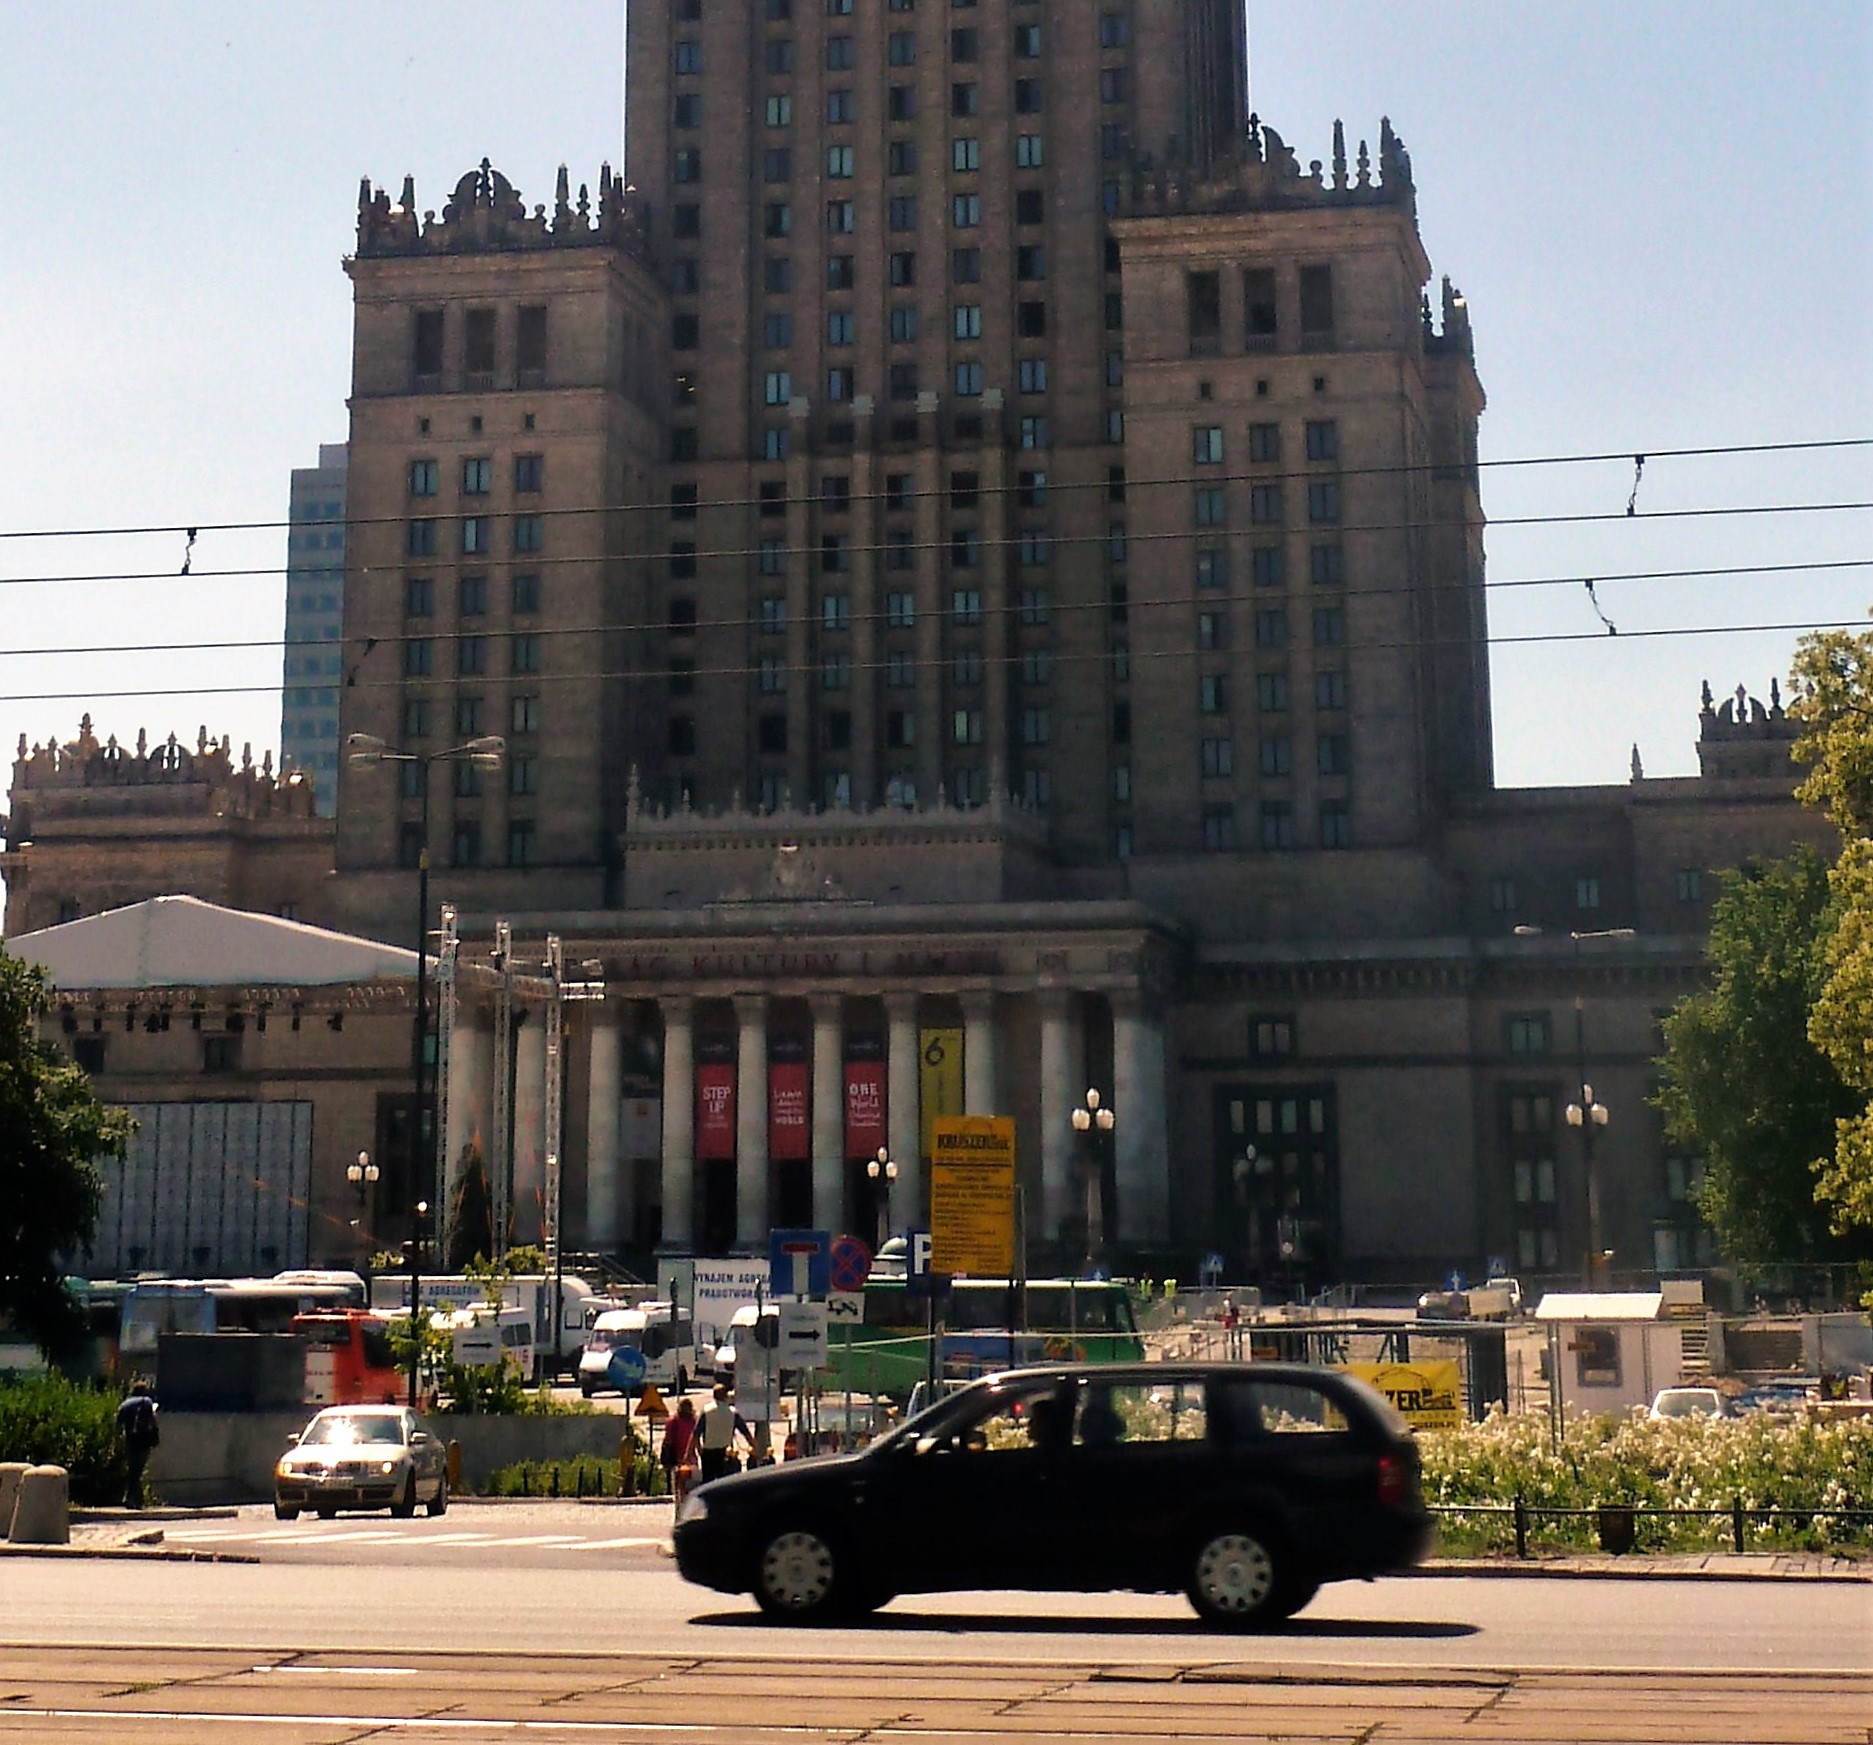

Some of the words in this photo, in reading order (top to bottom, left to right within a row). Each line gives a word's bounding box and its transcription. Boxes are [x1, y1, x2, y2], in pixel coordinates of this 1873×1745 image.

[925, 1037, 944, 1066] 6
[703, 1087, 731, 1100] STEP
[709, 1102, 724, 1113] UP
[914, 1233, 932, 1274] P
